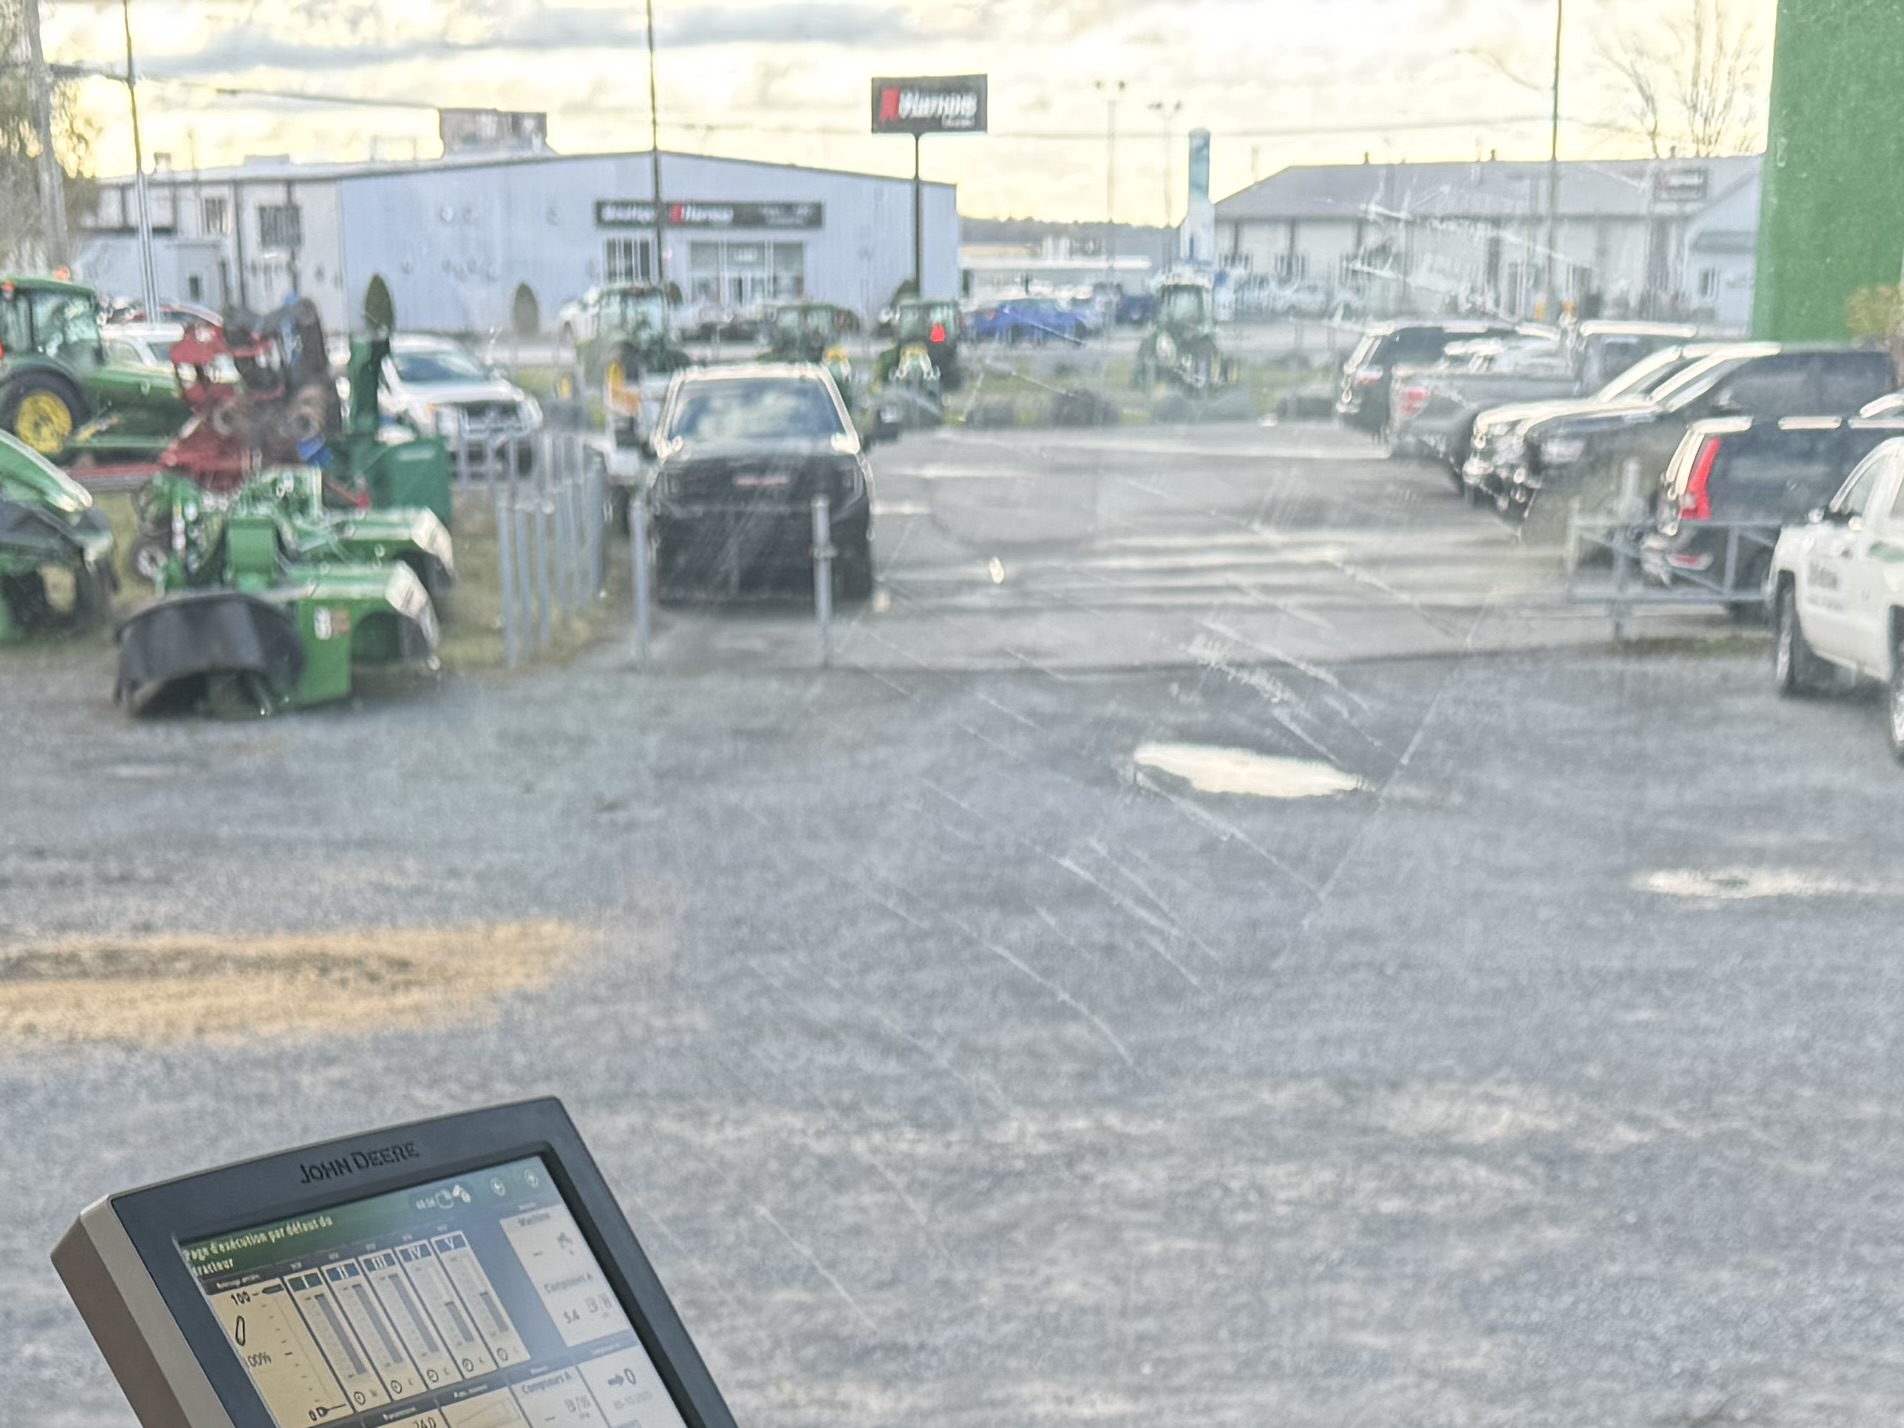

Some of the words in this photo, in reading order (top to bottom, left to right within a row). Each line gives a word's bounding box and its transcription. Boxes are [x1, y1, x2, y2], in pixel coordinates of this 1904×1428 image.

[299, 1158, 352, 1184] JOHN
[351, 1142, 420, 1171] DEERE
[267, 1227, 286, 1244] par
[285, 1218, 319, 1238] défaut
[318, 1214, 333, 1230] du
[231, 1290, 251, 1307] 100
